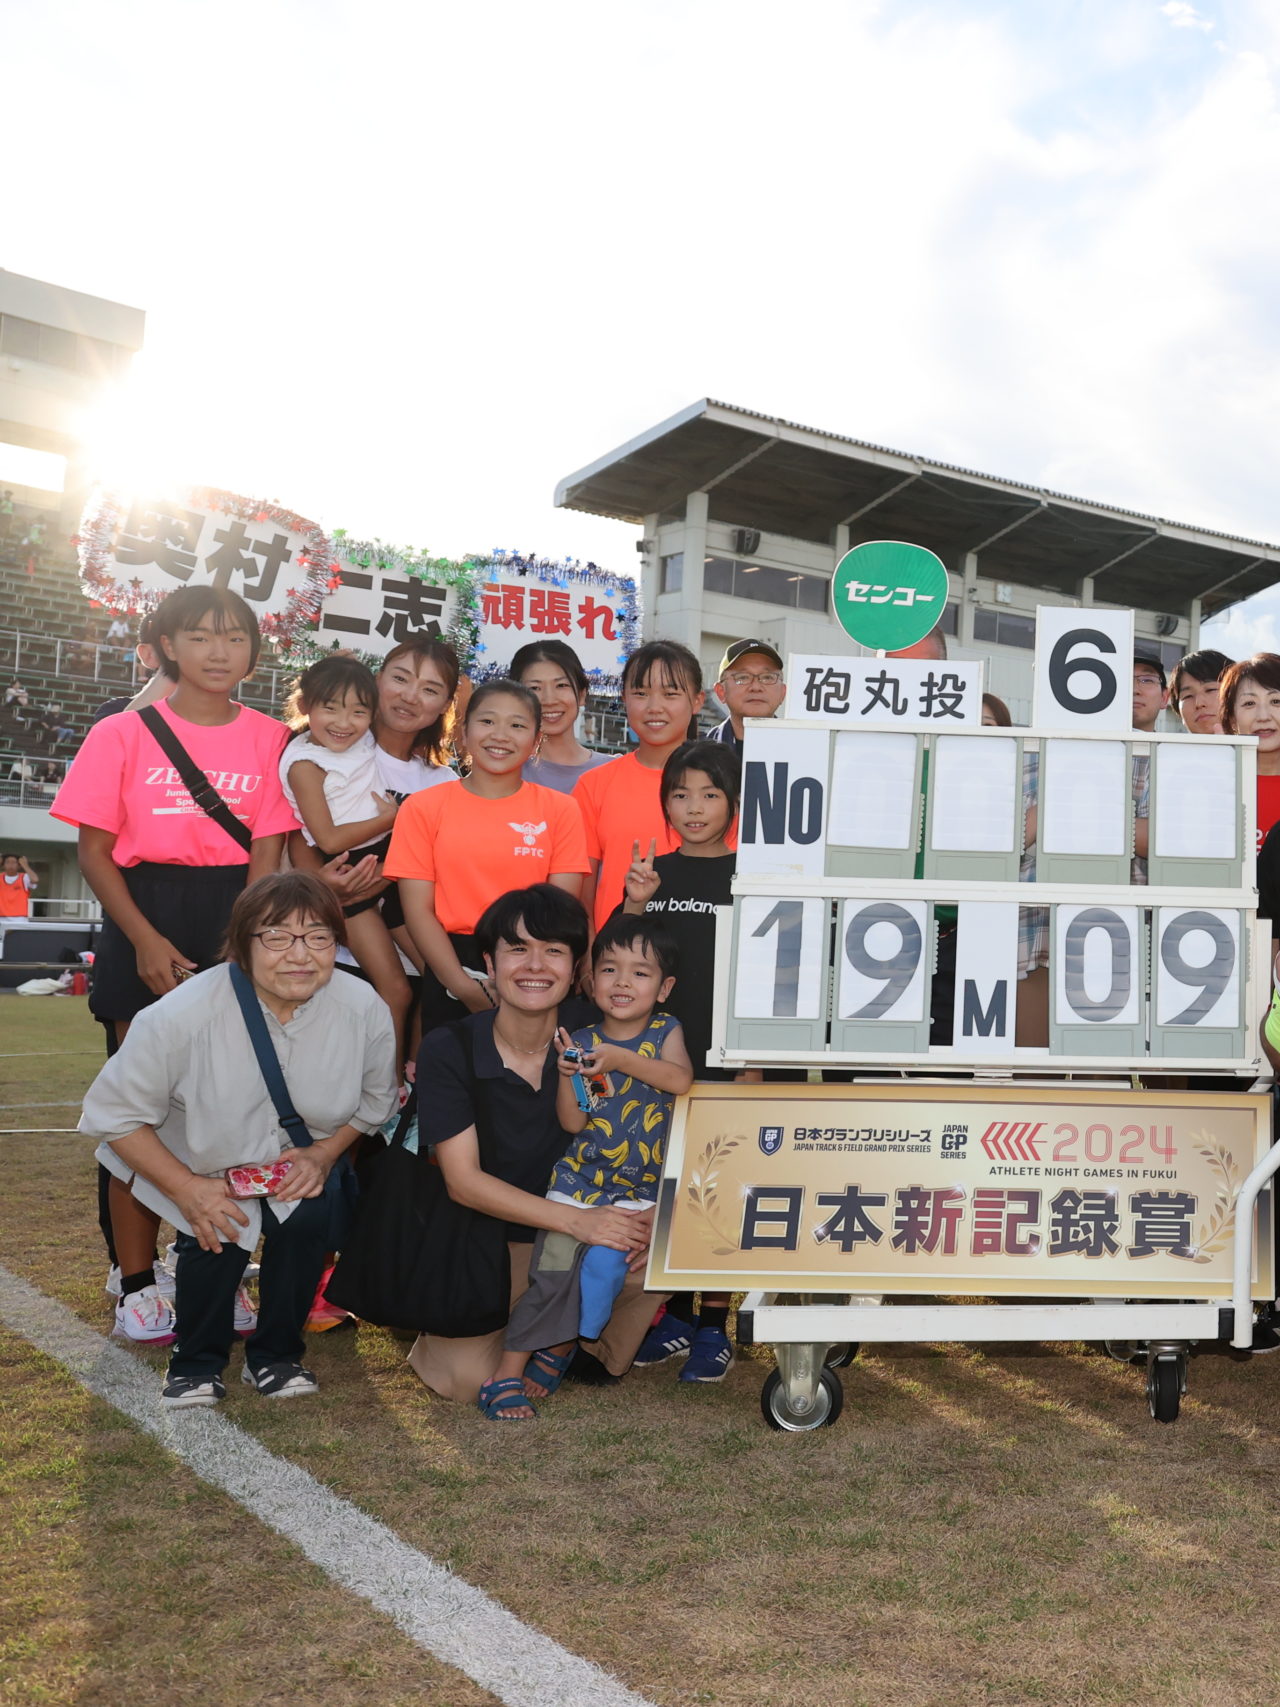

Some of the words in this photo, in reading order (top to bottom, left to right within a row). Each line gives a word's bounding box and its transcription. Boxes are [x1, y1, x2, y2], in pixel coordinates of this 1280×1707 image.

[844, 580, 935, 607] センコー
[481, 582, 619, 641] 頑張れ
[1048, 628, 1118, 715] 6
[803, 667, 967, 720] 砲丸投
[145, 767, 262, 793] ZECHU
[740, 761, 824, 845] No
[513, 847, 545, 858] FPTC
[644, 900, 666, 912] ew
[668, 897, 719, 915] balanc
[962, 978, 1008, 1037] M
[793, 1127, 932, 1142] 日本グランプリシリーズ
[941, 1134, 968, 1150] GP
[942, 1125, 968, 1133] JAPAN
[793, 1143, 814, 1151] JAPAN
[815, 1143, 836, 1151] TRACK
[838, 1144, 843, 1152] &
[844, 1144, 863, 1152] FIELD
[864, 1144, 887, 1152] GRAND
[906, 1145, 931, 1153] SERIES
[940, 1151, 967, 1159] SERIES
[1052, 1123, 1178, 1164] 2024
[989, 1166, 1041, 1176] ATHLETE
[1044, 1167, 1080, 1177] NIGHT
[1083, 1168, 1123, 1178] GAMES
[1127, 1169, 1139, 1178] IN
[1142, 1169, 1177, 1179] FUKUI
[738, 1184, 1199, 1259] 日本新記録賞
